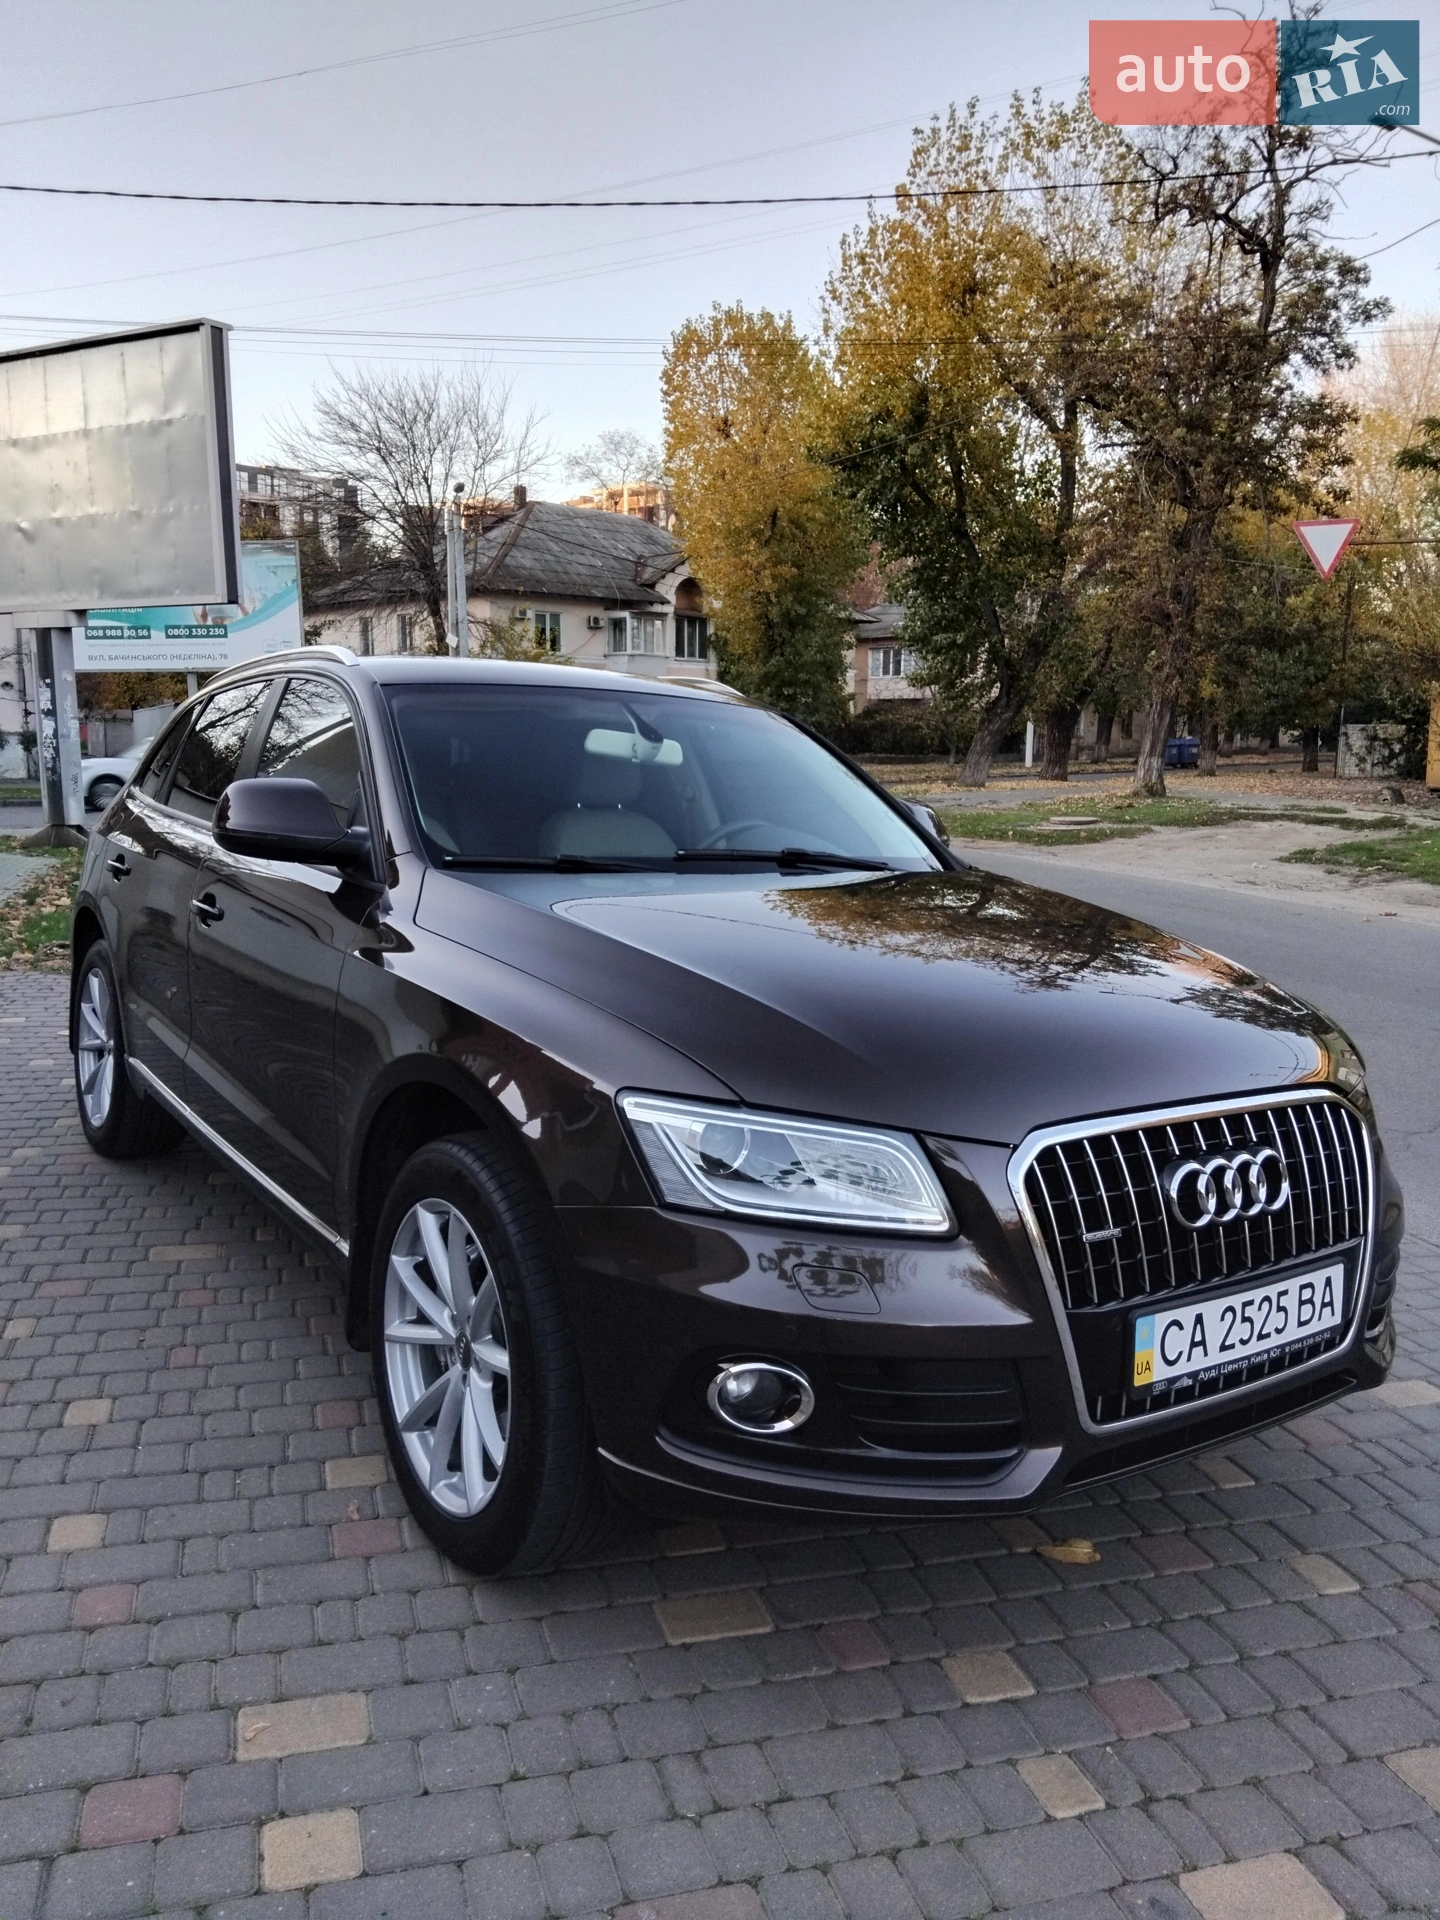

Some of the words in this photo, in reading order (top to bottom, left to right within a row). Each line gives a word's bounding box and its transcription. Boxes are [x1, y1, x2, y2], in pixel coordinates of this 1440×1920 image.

[86, 629, 104, 637] 068
[105, 629, 122, 637] 988
[137, 629, 149, 637] 56
[167, 628, 190, 636] 0800
[191, 628, 206, 636] 330
[208, 627, 225, 636] 230
[88, 654, 107, 662] ВУЛ.
[1159, 1312, 1209, 1367] CA
[1218, 1289, 1289, 1354] 2525
[1296, 1275, 1335, 1329] BA
[1136, 1360, 1152, 1376] UA
[1197, 1361, 1219, 1381] Ауді
[1220, 1357, 1249, 1375] Центр
[1250, 1351, 1268, 1365] Київ
[1269, 1348, 1282, 1359] Юг
